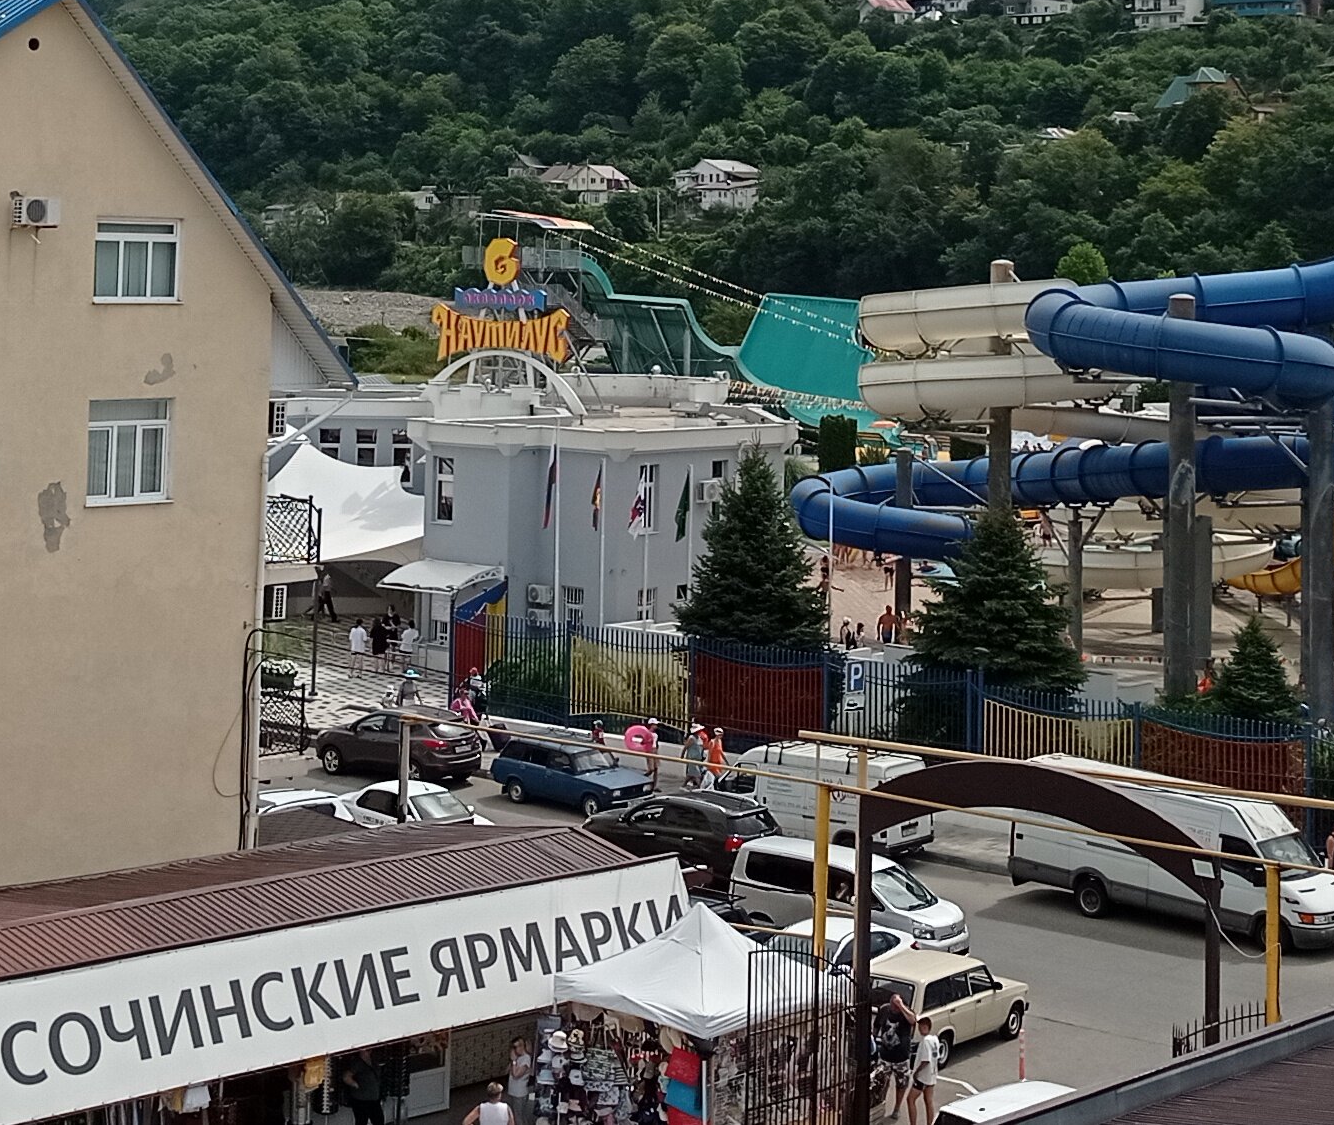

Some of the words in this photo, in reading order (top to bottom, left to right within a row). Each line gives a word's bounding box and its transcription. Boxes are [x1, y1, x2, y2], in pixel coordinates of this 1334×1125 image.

[431, 303, 570, 363] НАУТИЛУС
[851, 663, 862, 690] P
[1, 946, 420, 1086] СОЧИНСКИЕ
[430, 894, 683, 998] ЯРМАРКИ
